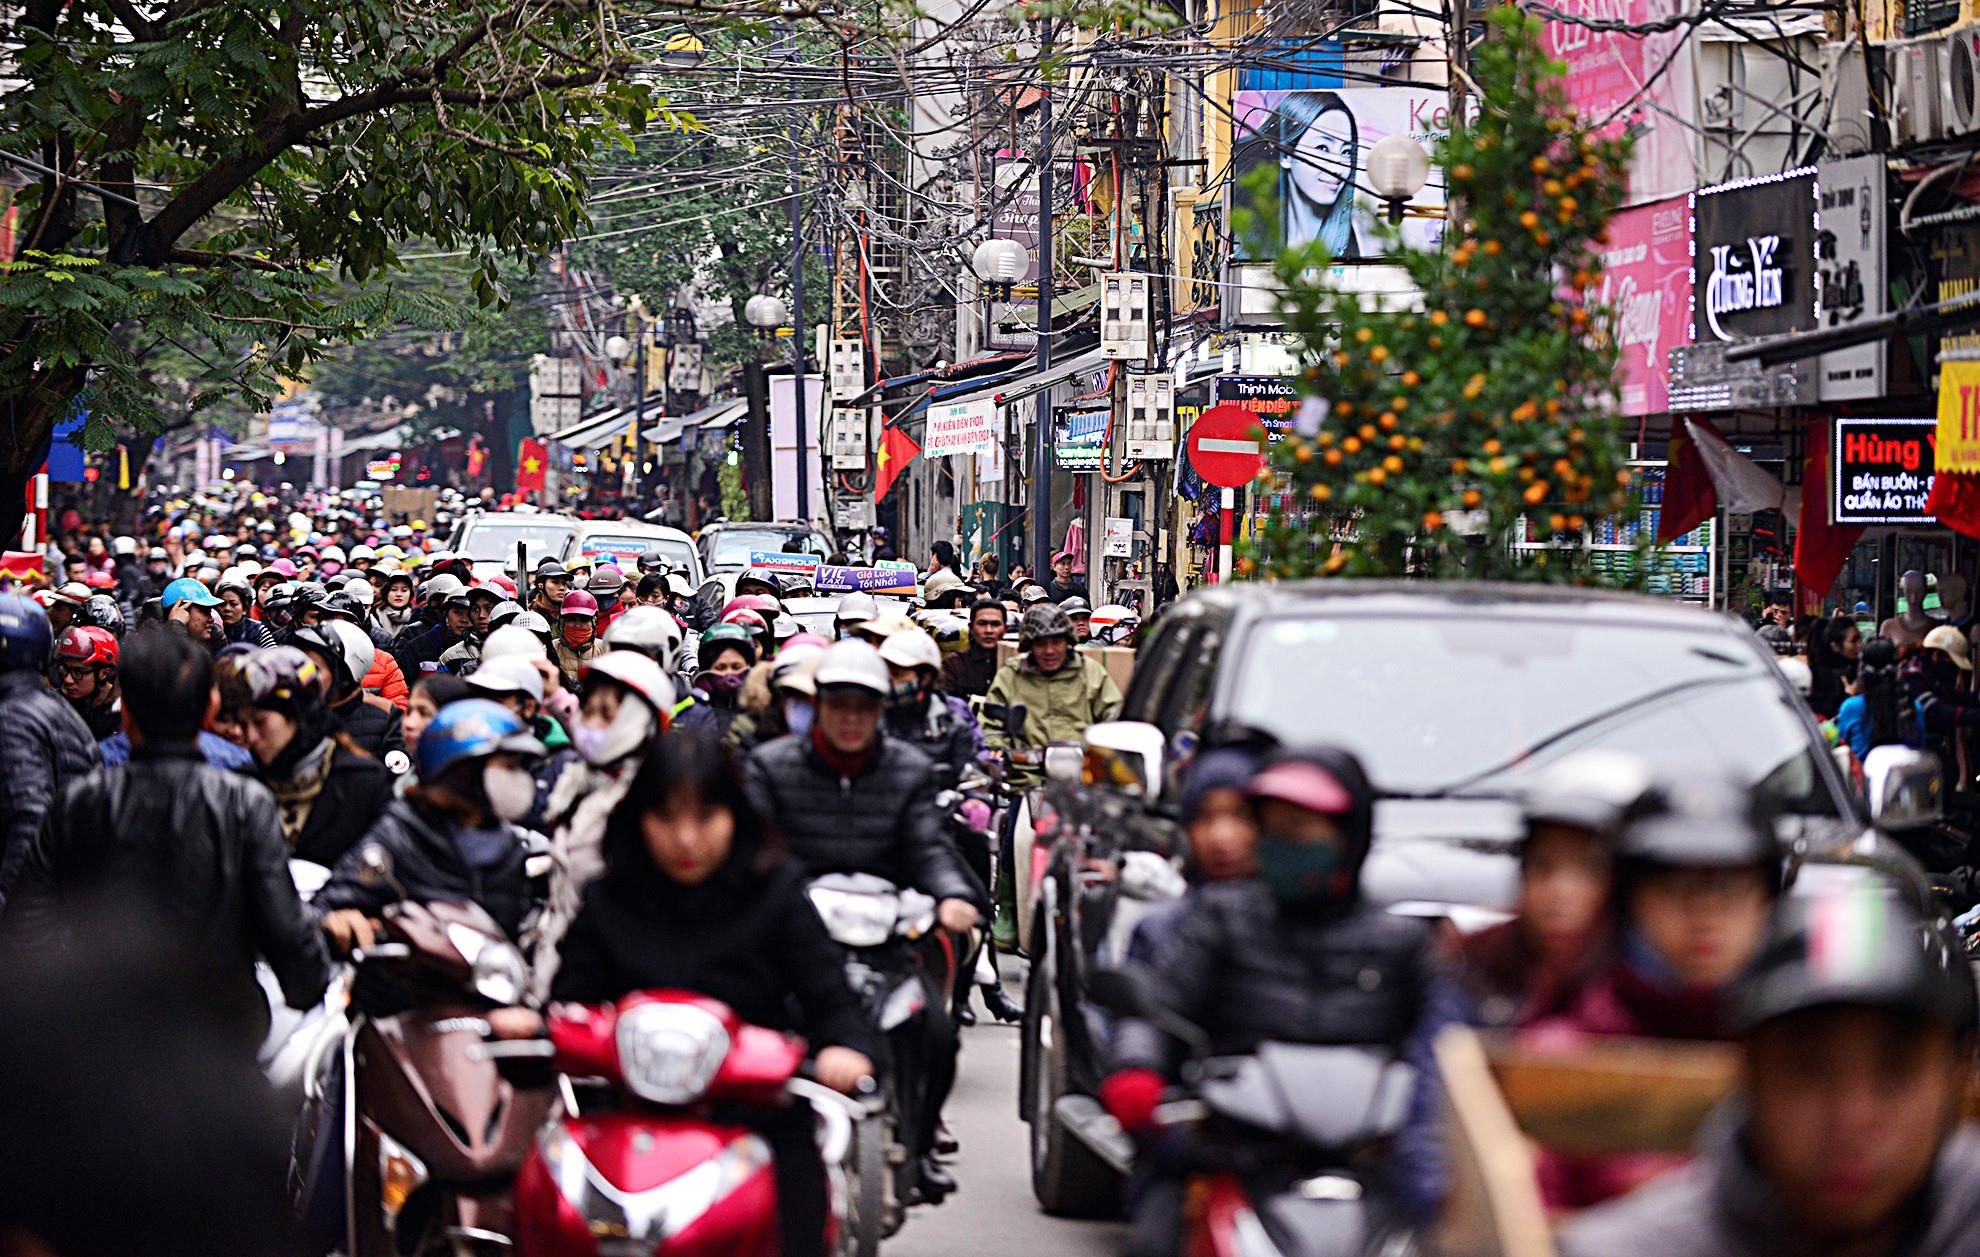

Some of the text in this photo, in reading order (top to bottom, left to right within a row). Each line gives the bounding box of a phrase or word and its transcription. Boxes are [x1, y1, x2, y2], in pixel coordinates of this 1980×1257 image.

[1238, 384, 1266, 396] Thịnh
[1845, 433, 1920, 470] Hùng
[1852, 472, 1880, 490] BÁN
[1881, 472, 1918, 490] BUÔN
[1883, 491, 1902, 510] ÁO
[759, 556, 818, 566] TAXIGROUP
[821, 567, 847, 579] VIC
[857, 570, 873, 579] Giá
[859, 579, 873, 588] Tốt
[874, 578, 897, 587] Nhất
